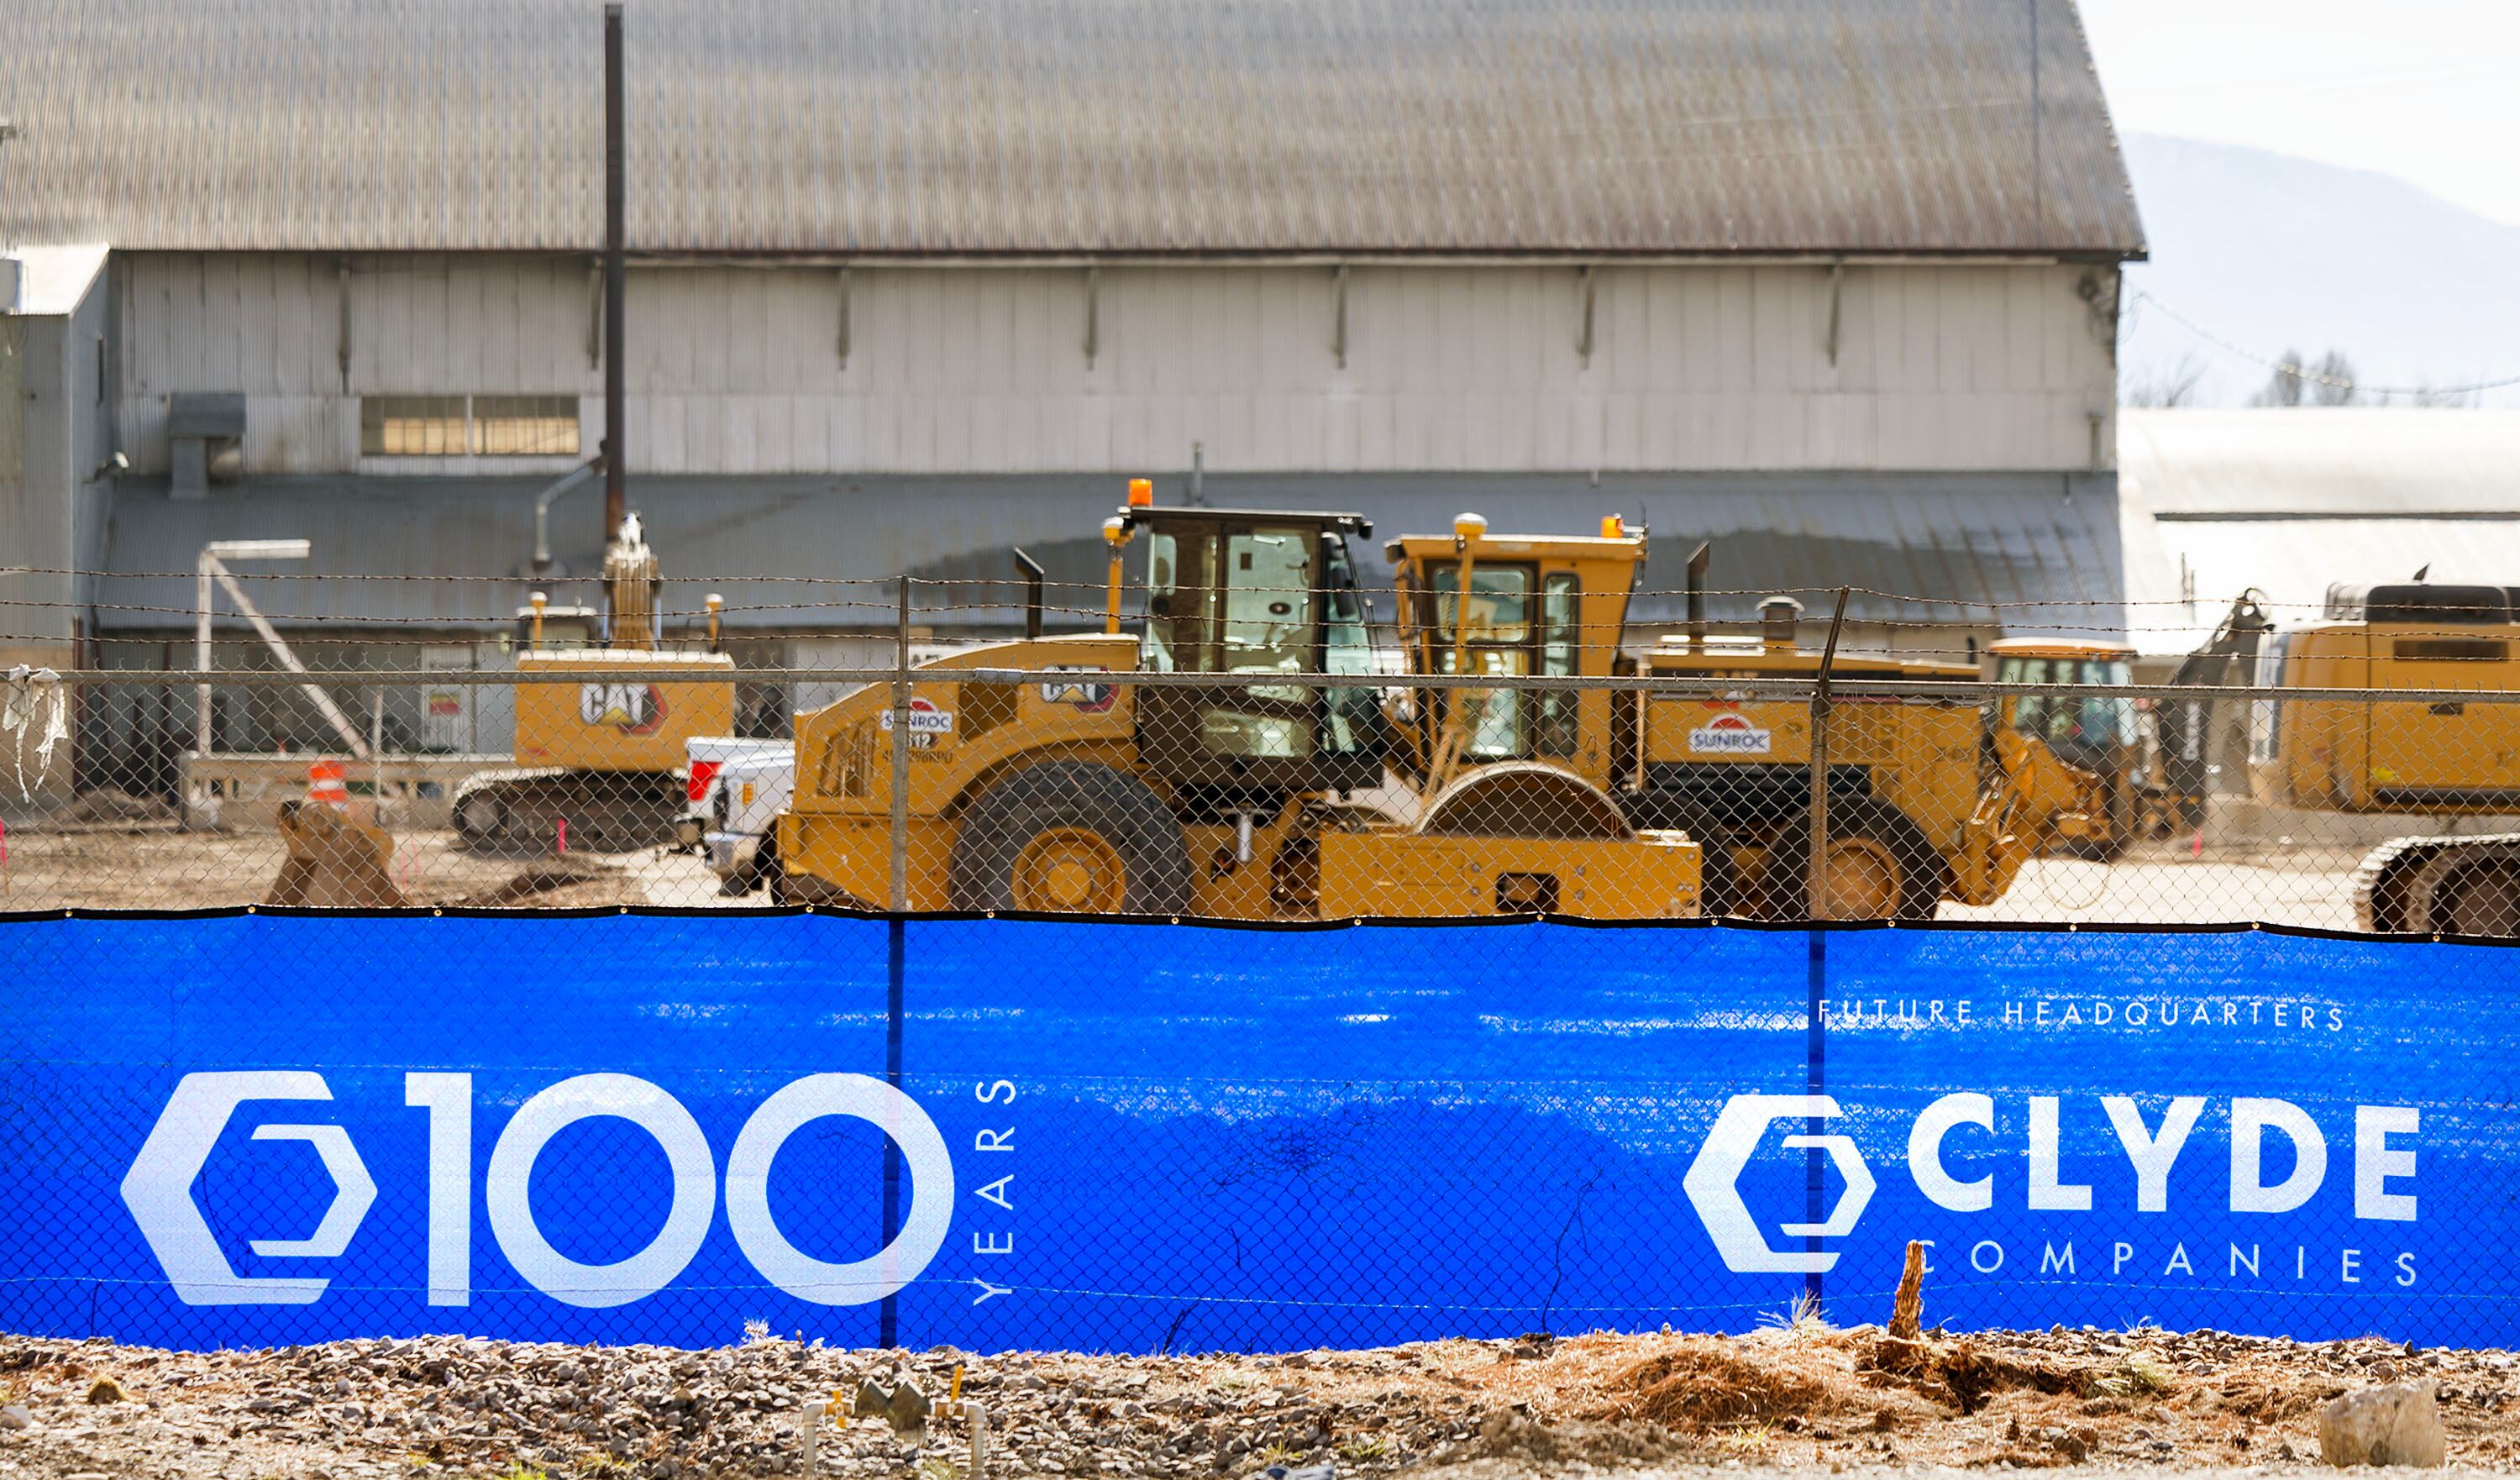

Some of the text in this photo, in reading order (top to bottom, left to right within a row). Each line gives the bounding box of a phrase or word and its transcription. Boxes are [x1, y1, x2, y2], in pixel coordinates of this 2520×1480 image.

[580, 682, 648, 724] CAT
[885, 715, 950, 728] SNROC
[1693, 733, 1767, 748] SUNROC
[1818, 999, 2343, 1032] FUTURE HEADQUARTERS
[1908, 1092, 2420, 1221] CLYDE
[405, 1072, 955, 1309] 100
[973, 1079, 1017, 1307] YEARS
